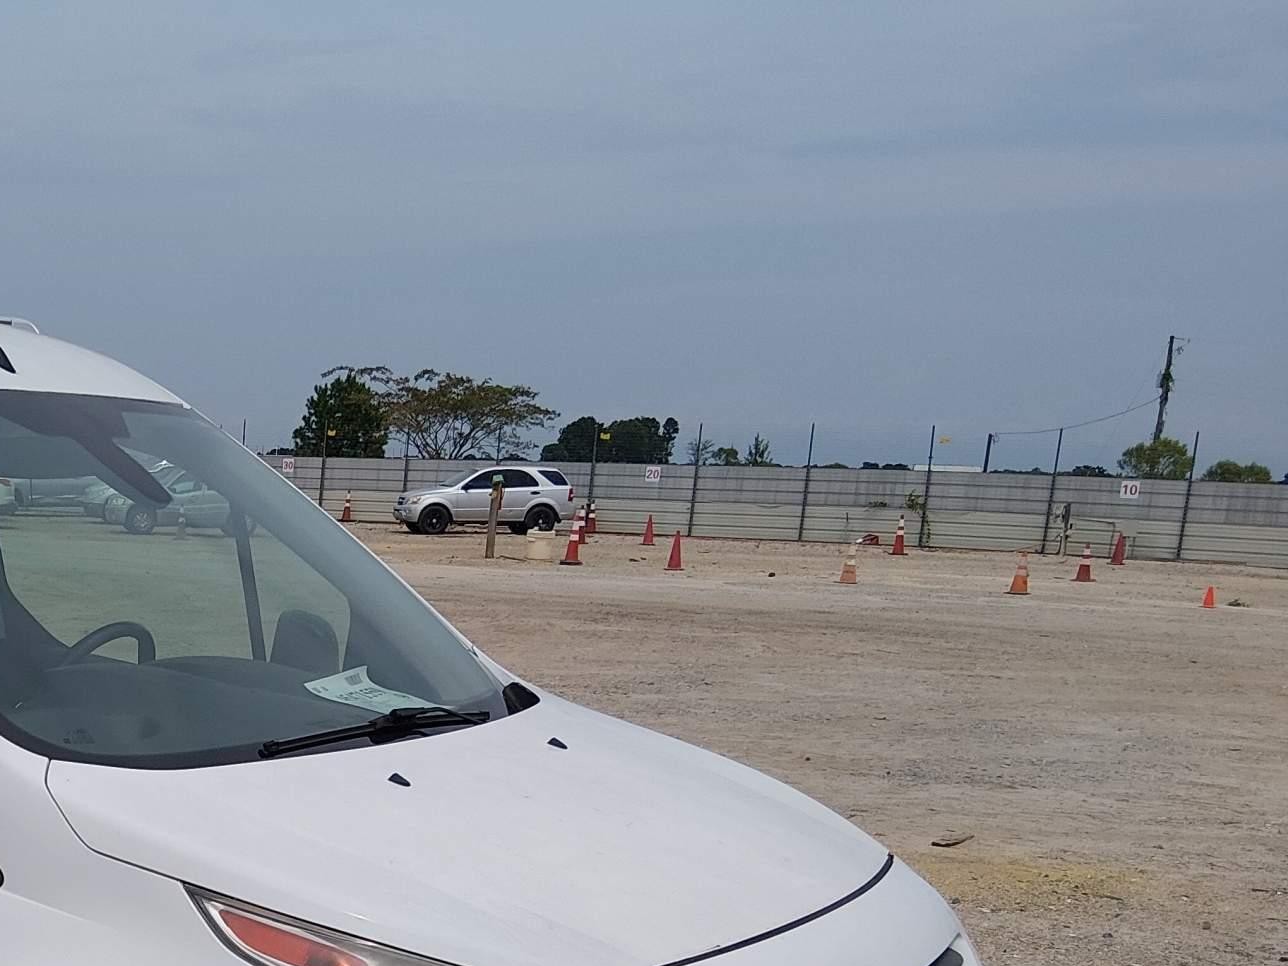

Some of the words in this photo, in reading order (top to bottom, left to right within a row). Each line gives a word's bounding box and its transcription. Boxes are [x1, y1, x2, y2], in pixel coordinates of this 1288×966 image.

[283, 461, 293, 470] 30
[647, 469, 660, 479] 20
[1122, 484, 1138, 496] 10
